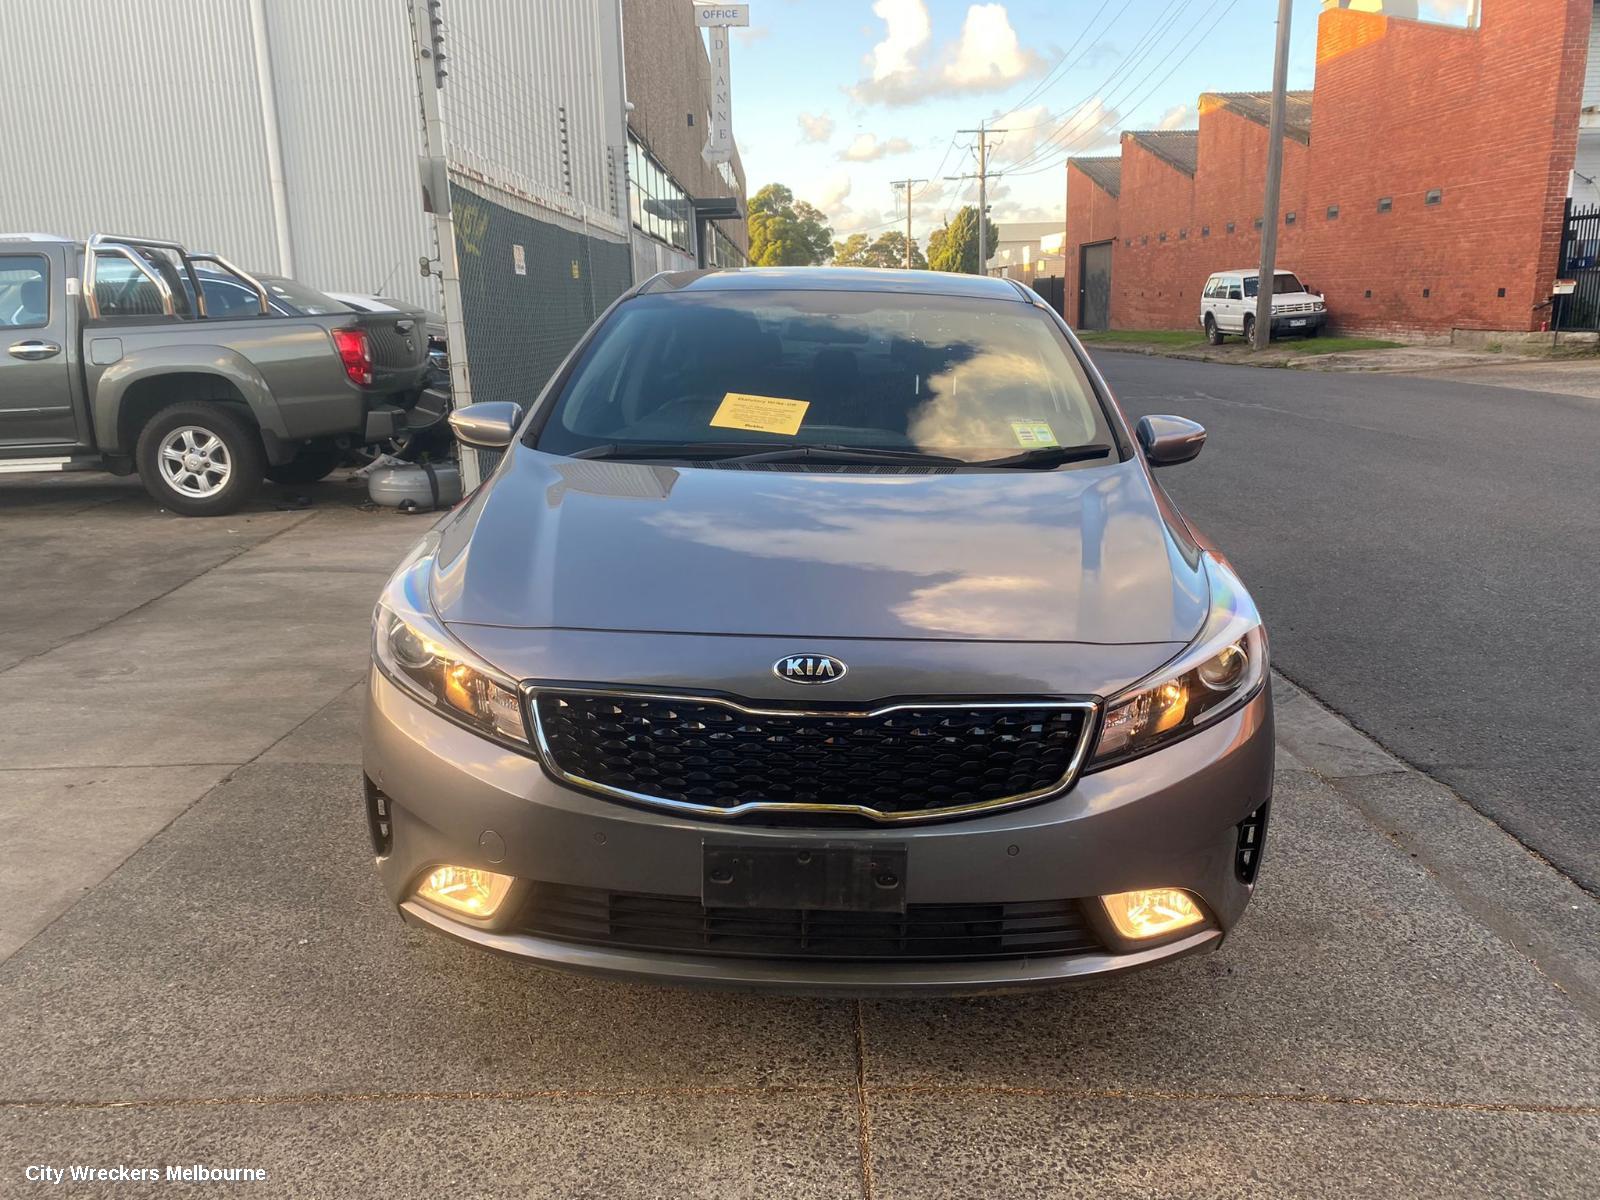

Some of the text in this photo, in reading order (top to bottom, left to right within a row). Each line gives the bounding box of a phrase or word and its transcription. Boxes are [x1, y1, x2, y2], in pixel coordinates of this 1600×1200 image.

[702, 9, 738, 19] OFFICE
[714, 39, 728, 140] DIANNE
[786, 658, 835, 677] KIA
